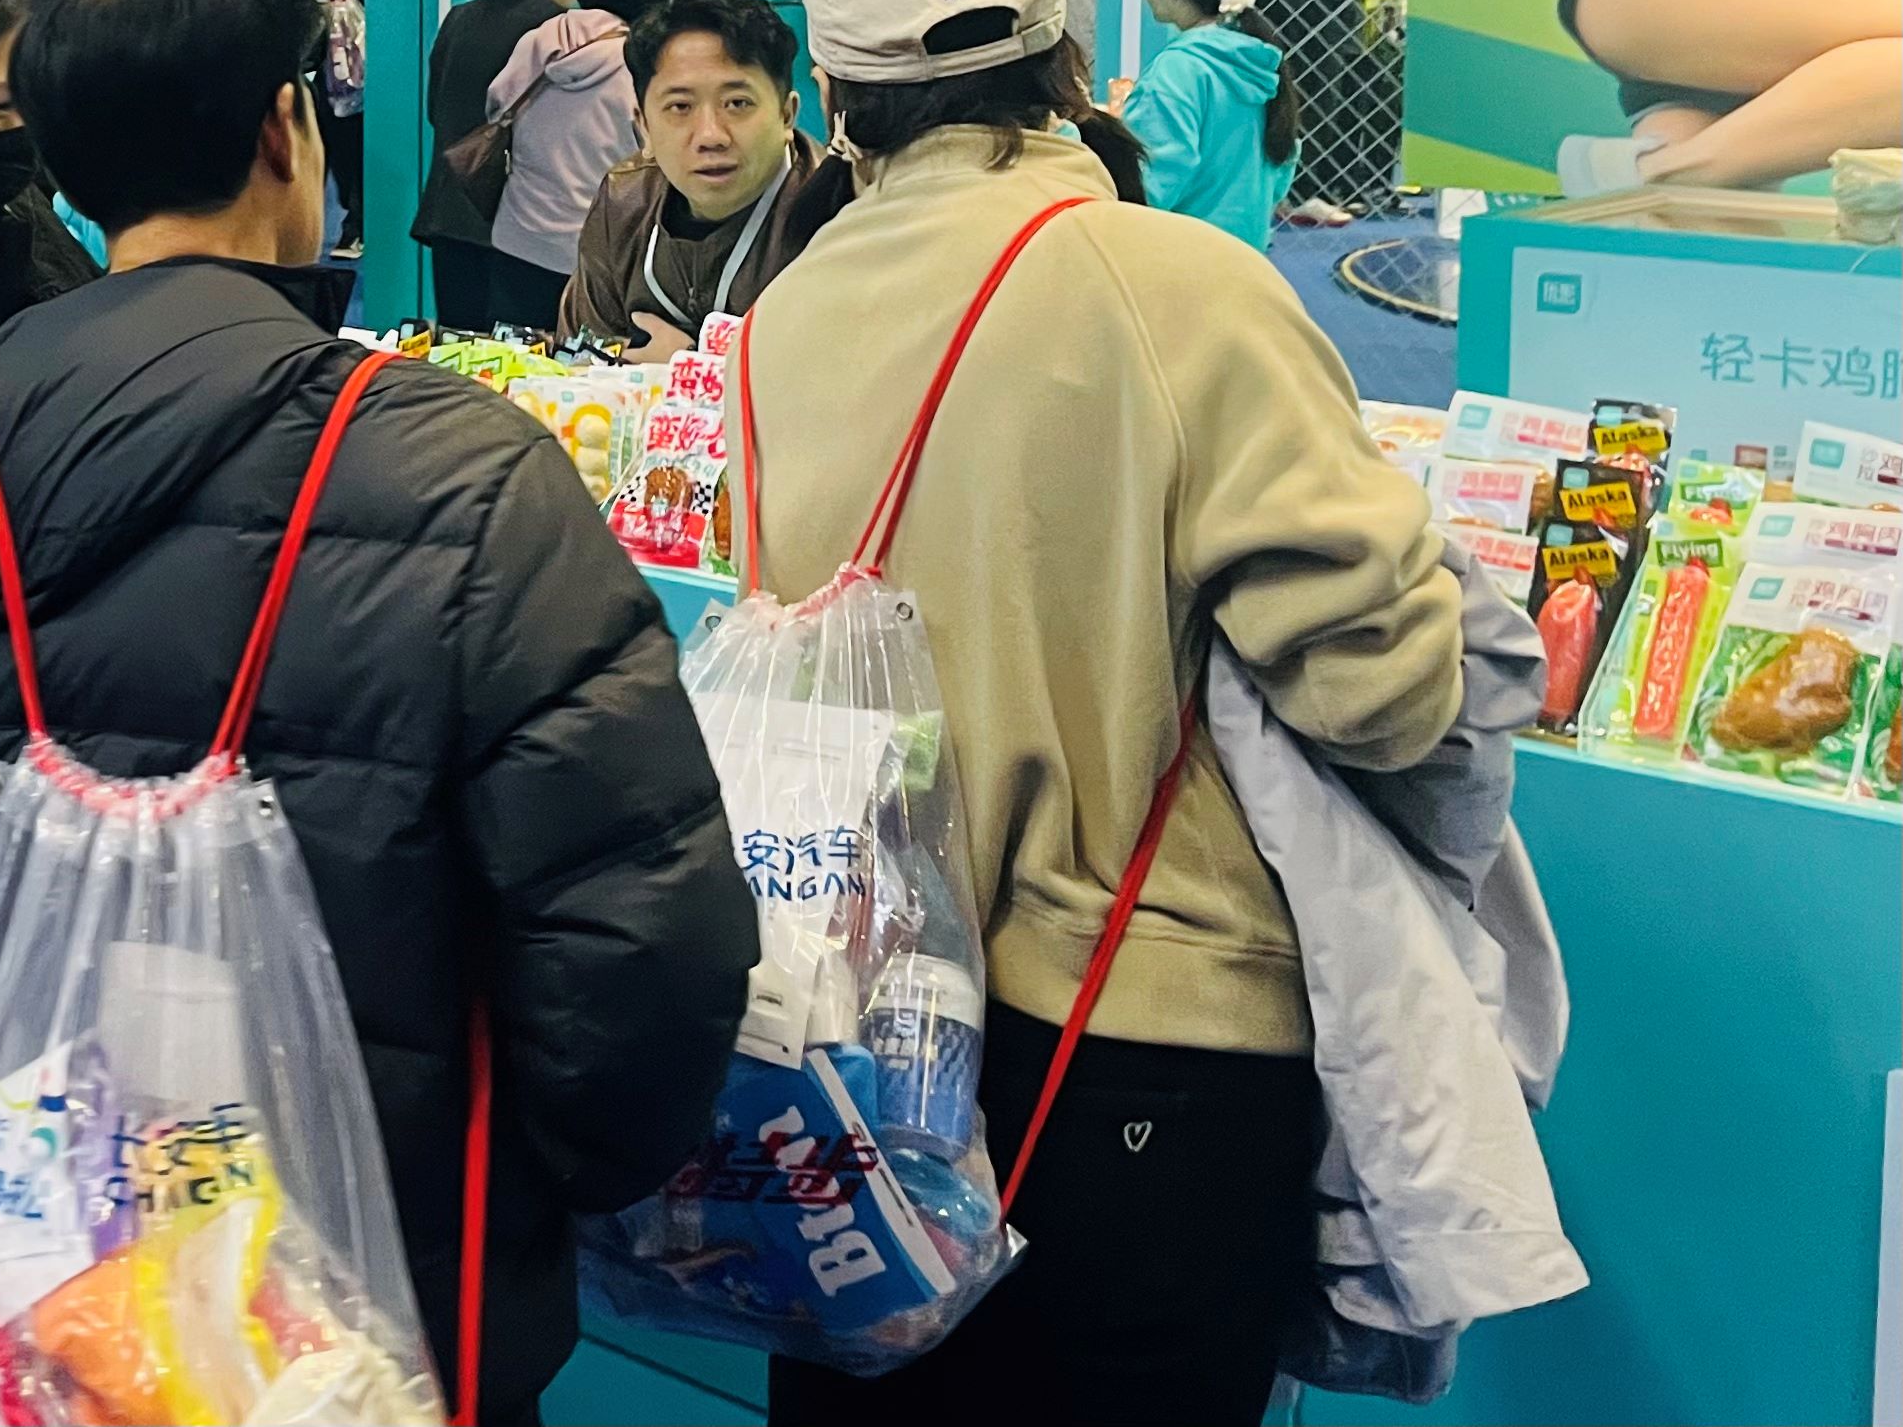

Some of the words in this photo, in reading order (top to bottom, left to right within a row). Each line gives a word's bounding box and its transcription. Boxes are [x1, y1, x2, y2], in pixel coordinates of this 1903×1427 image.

[1601, 424, 1660, 446] Alaska
[1567, 487, 1628, 510] Alaska
[1549, 546, 1610, 567] Alaska
